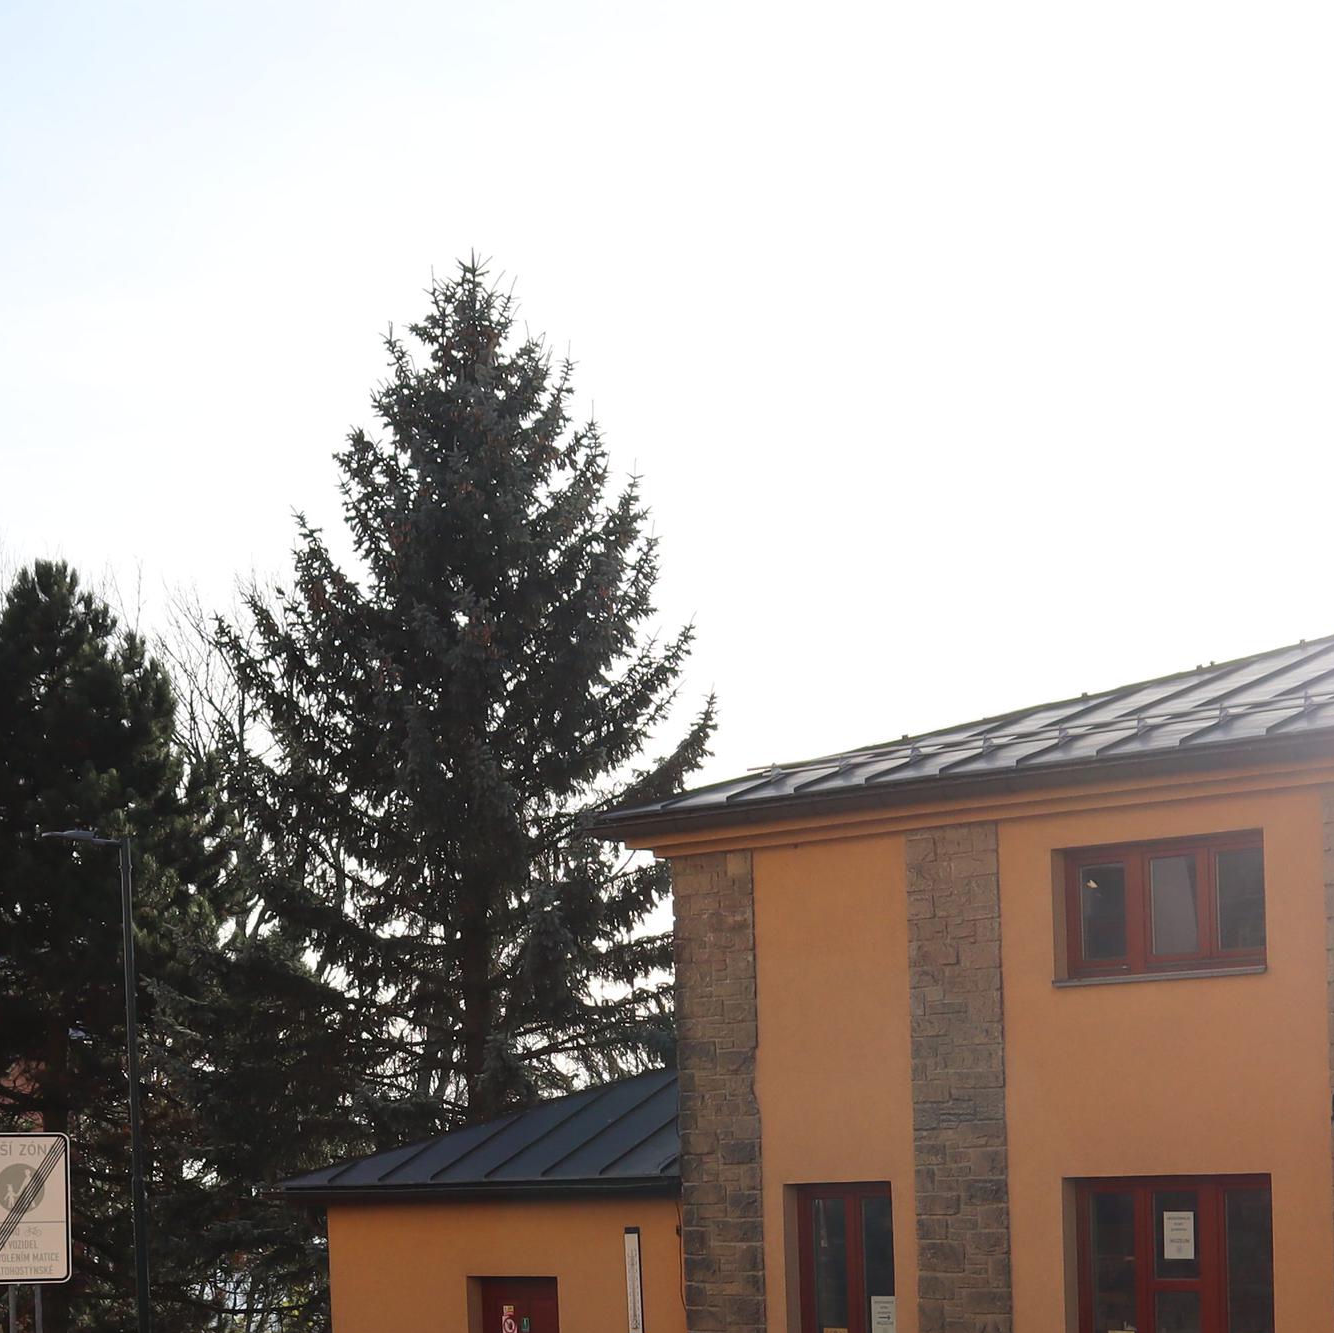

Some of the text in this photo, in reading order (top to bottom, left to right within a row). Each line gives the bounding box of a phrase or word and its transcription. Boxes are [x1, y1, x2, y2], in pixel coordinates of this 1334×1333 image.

[18, 1140, 51, 1157] ZÓN
[8, 1239, 38, 1249] VOZIDEL
[32, 1251, 59, 1262] MATICE
